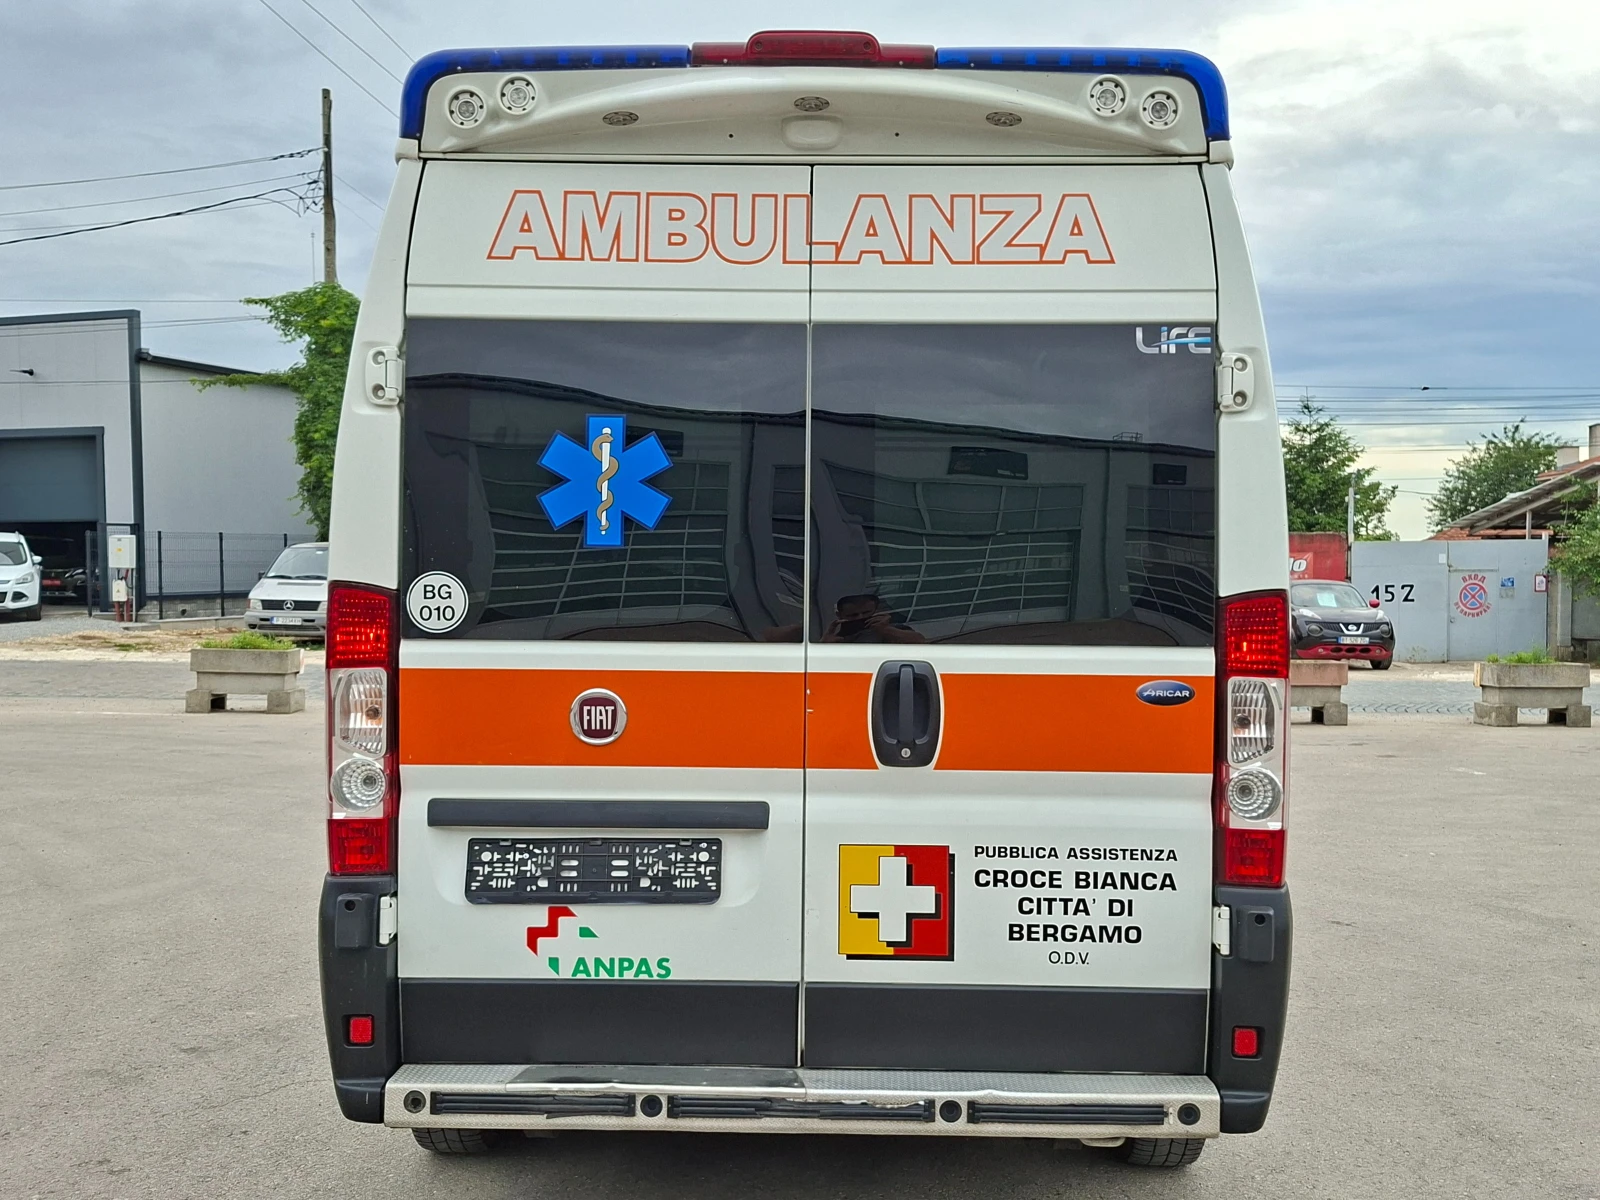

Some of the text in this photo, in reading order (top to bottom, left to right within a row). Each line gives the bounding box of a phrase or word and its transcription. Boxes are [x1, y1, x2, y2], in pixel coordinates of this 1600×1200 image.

[486, 189, 1116, 265] AMBULANZA
[423, 583, 453, 600] BG
[1370, 584, 1415, 603] 152
[419, 605, 456, 622] 010
[1142, 688, 1190, 698] ARICAR
[583, 705, 614, 730] FIAT
[974, 845, 1178, 862] PUBBLICA ASSISTENZA
[974, 869, 1178, 891] CROCE BIANCA
[1017, 896, 1134, 917] CITTA' DI
[1008, 923, 1143, 944] BERGAMO
[571, 957, 672, 979] ANPAS
[1048, 950, 1090, 966] O.D.V.
